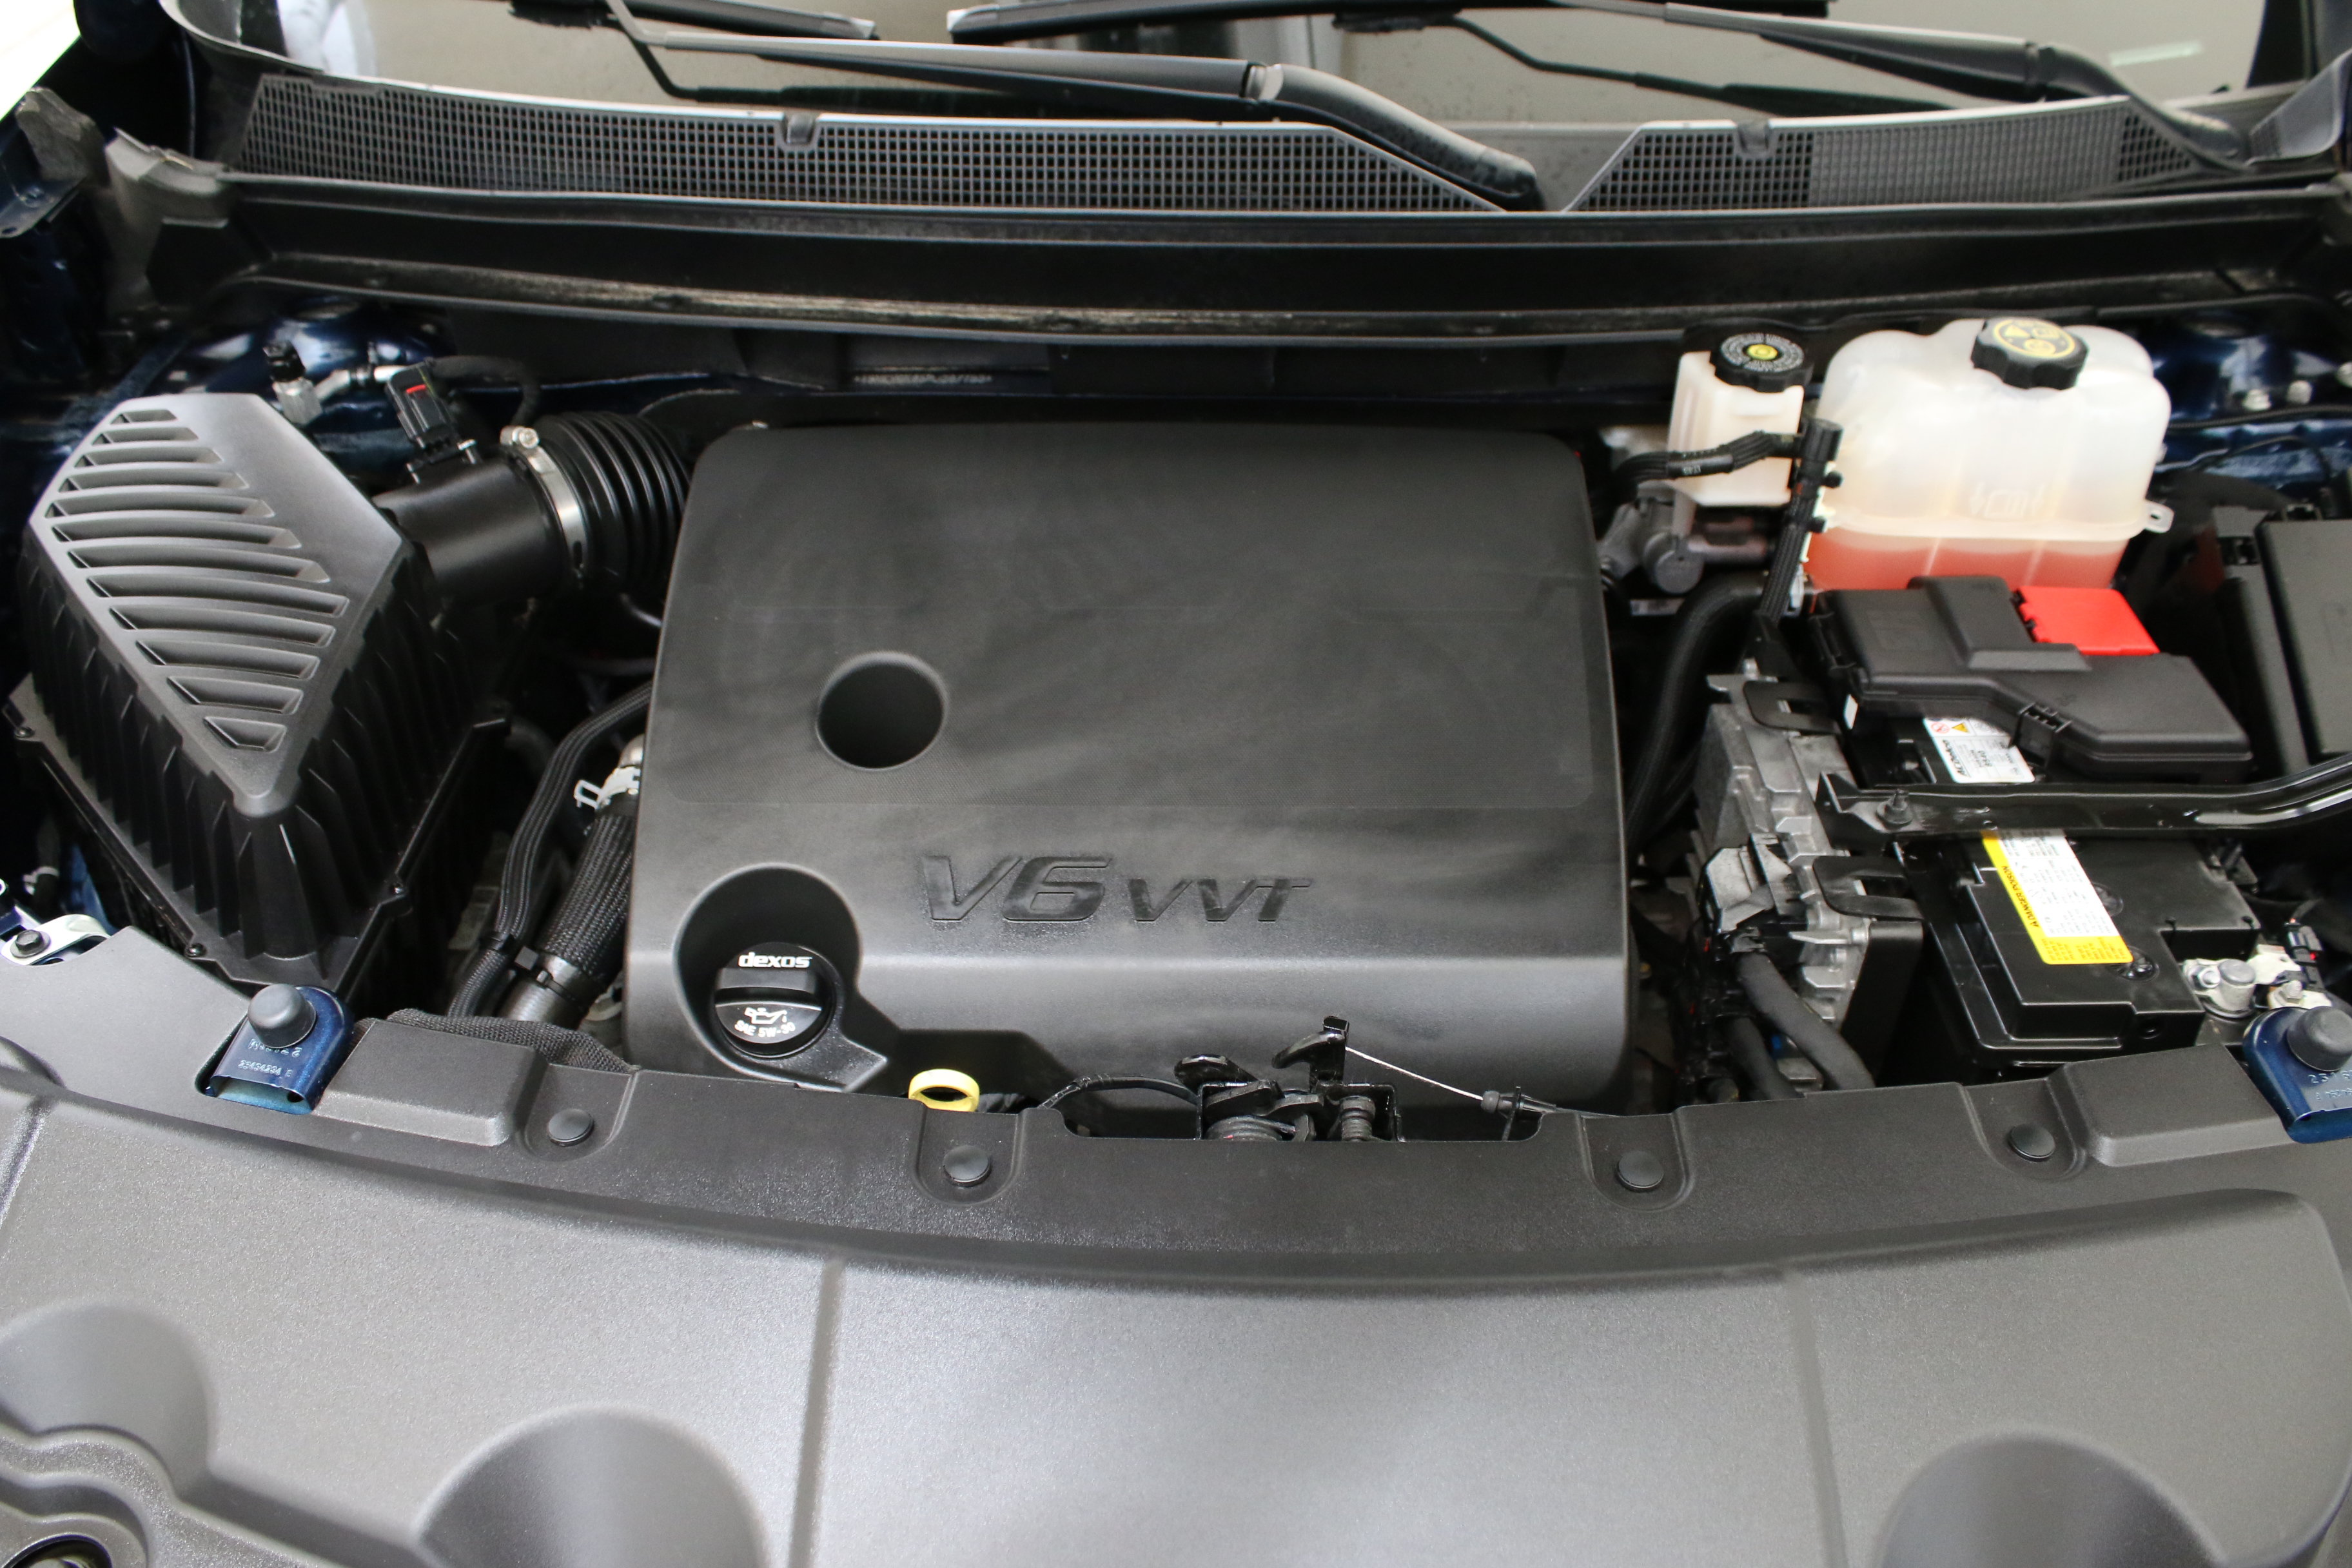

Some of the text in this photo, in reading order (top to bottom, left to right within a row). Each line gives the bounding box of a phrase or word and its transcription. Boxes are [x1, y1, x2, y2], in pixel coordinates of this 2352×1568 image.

[923, 854, 1314, 922] V6 VVT
[2001, 866, 2035, 921] DANGER POISON
[738, 951, 811, 969] dexos
[734, 1019, 796, 1038] SAE 5W-30
